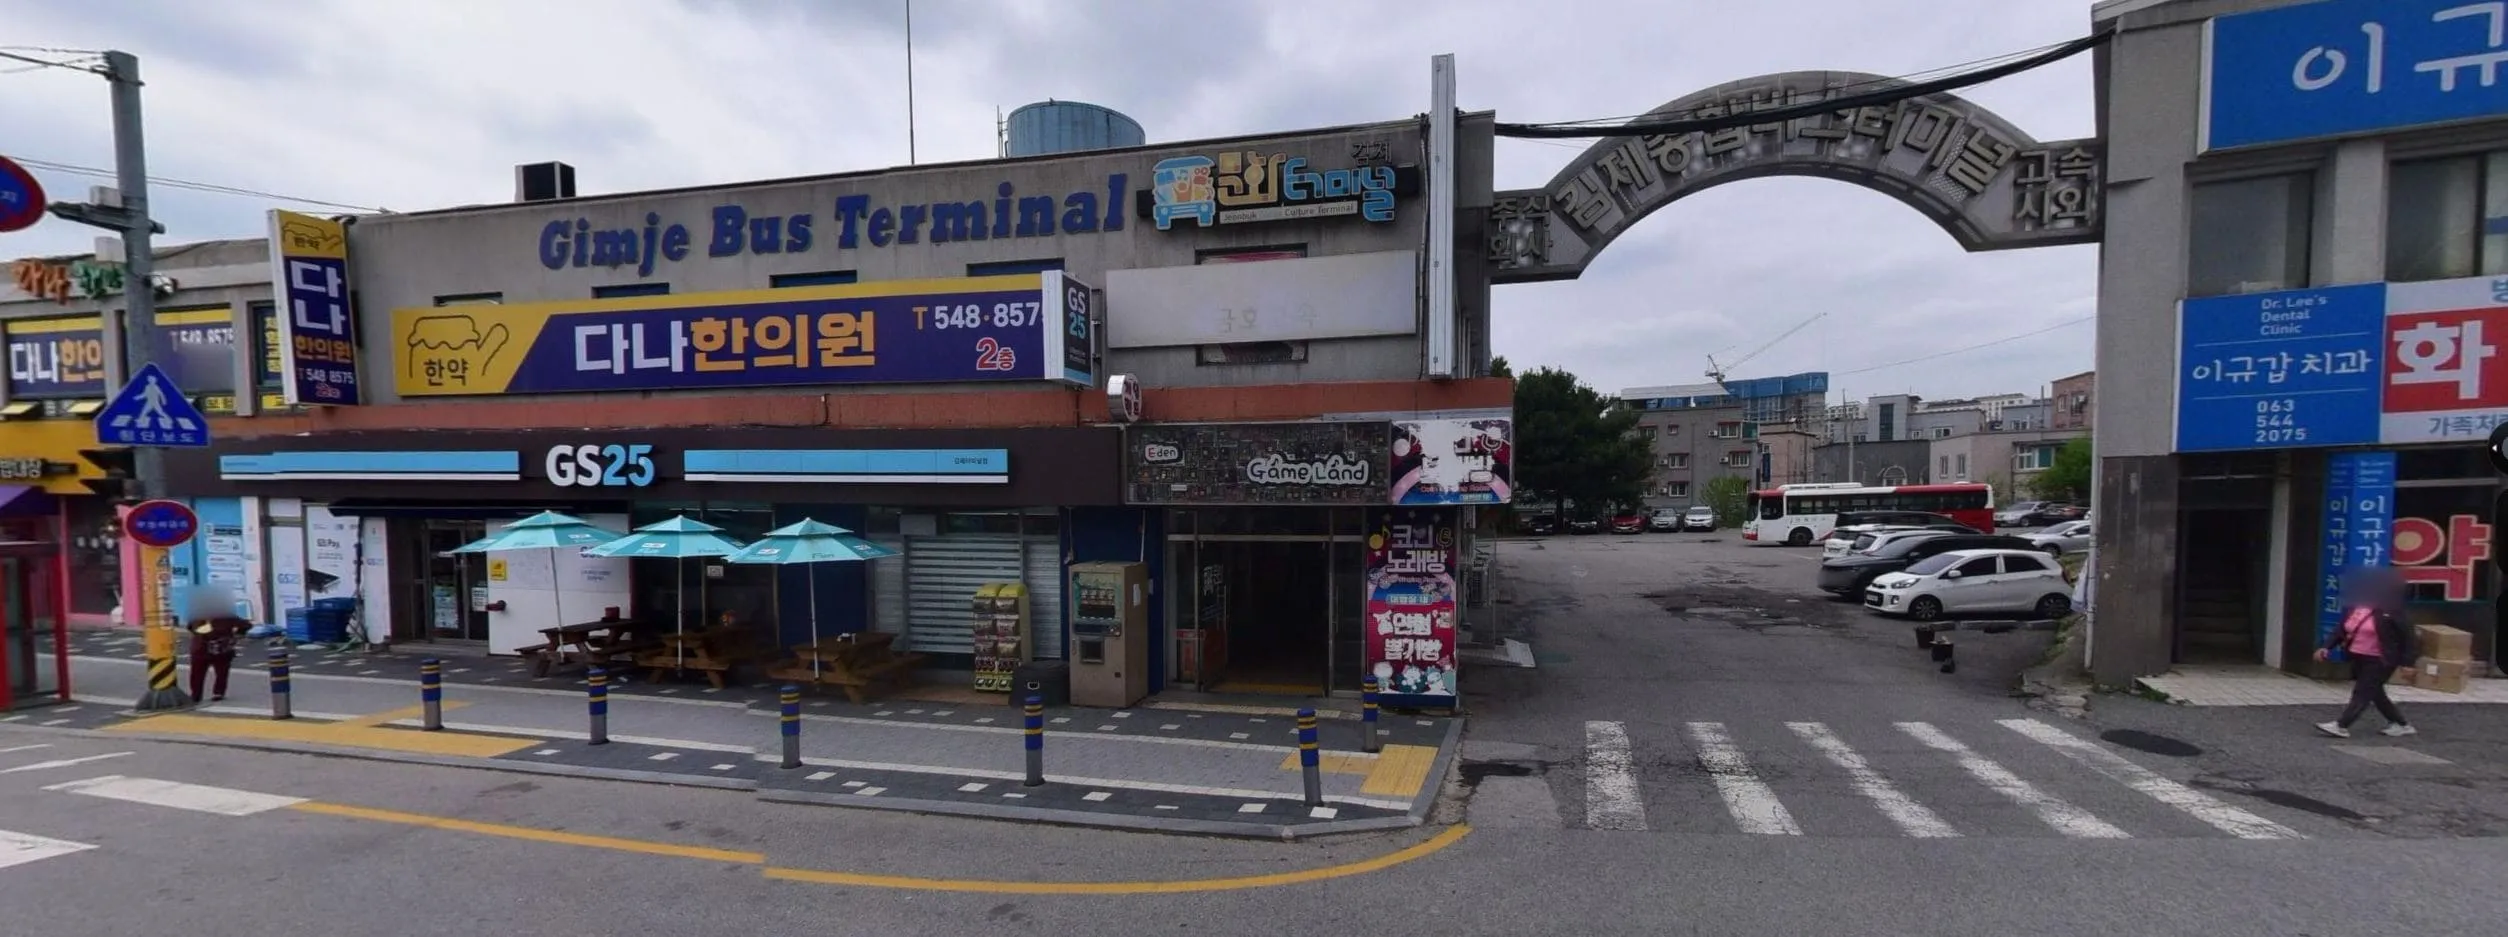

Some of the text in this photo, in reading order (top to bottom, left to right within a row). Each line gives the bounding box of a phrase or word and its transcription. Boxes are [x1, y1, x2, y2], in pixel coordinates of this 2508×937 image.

[539, 173, 1128, 277] Gimje Bus Terminal
[1067, 287, 1085, 314] GS
[2262, 298, 2283, 309] Dr.
[912, 306, 928, 330] T
[1069, 311, 1086, 339] 25
[2261, 309, 2311, 322] Dental
[2260, 324, 2302, 336] Clinic
[574, 310, 876, 375] 다나한의원
[2193, 349, 2374, 384] 이규갑 치과
[2391, 320, 2497, 400] 화
[423, 358, 470, 387] 한약
[2257, 400, 2295, 414] 063
[2256, 415, 2293, 428] 544
[2255, 428, 2307, 443] 2075
[1148, 447, 1177, 458] Eden
[545, 444, 655, 487] GS25
[1250, 459, 1365, 481] Game Land
[1386, 549, 1449, 573] 노래방
